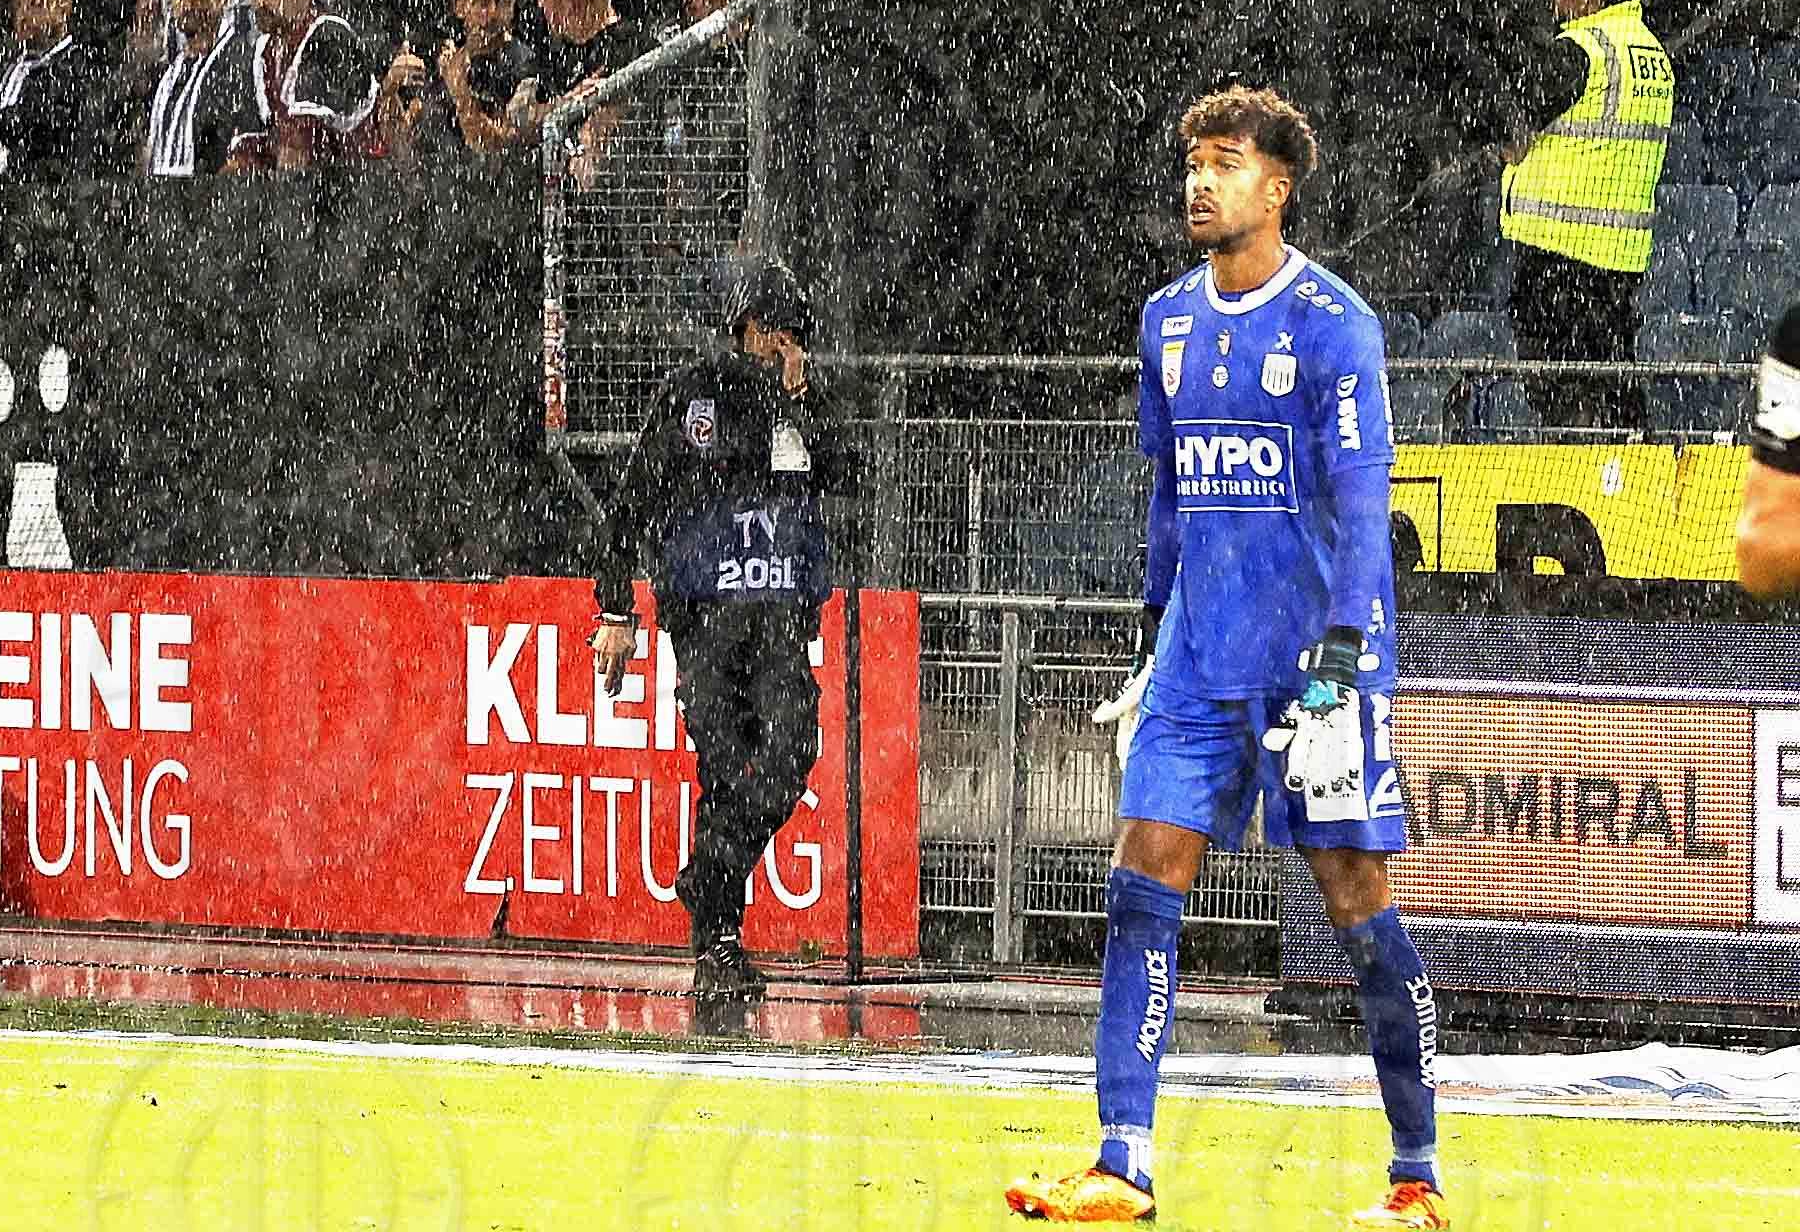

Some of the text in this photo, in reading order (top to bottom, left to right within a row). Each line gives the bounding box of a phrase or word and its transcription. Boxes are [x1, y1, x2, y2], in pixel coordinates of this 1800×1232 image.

[1175, 435, 1283, 477] HYPO
[734, 509, 779, 549] TV
[466, 623, 825, 754] KLEI
[464, 772, 823, 910] ZEITUG
